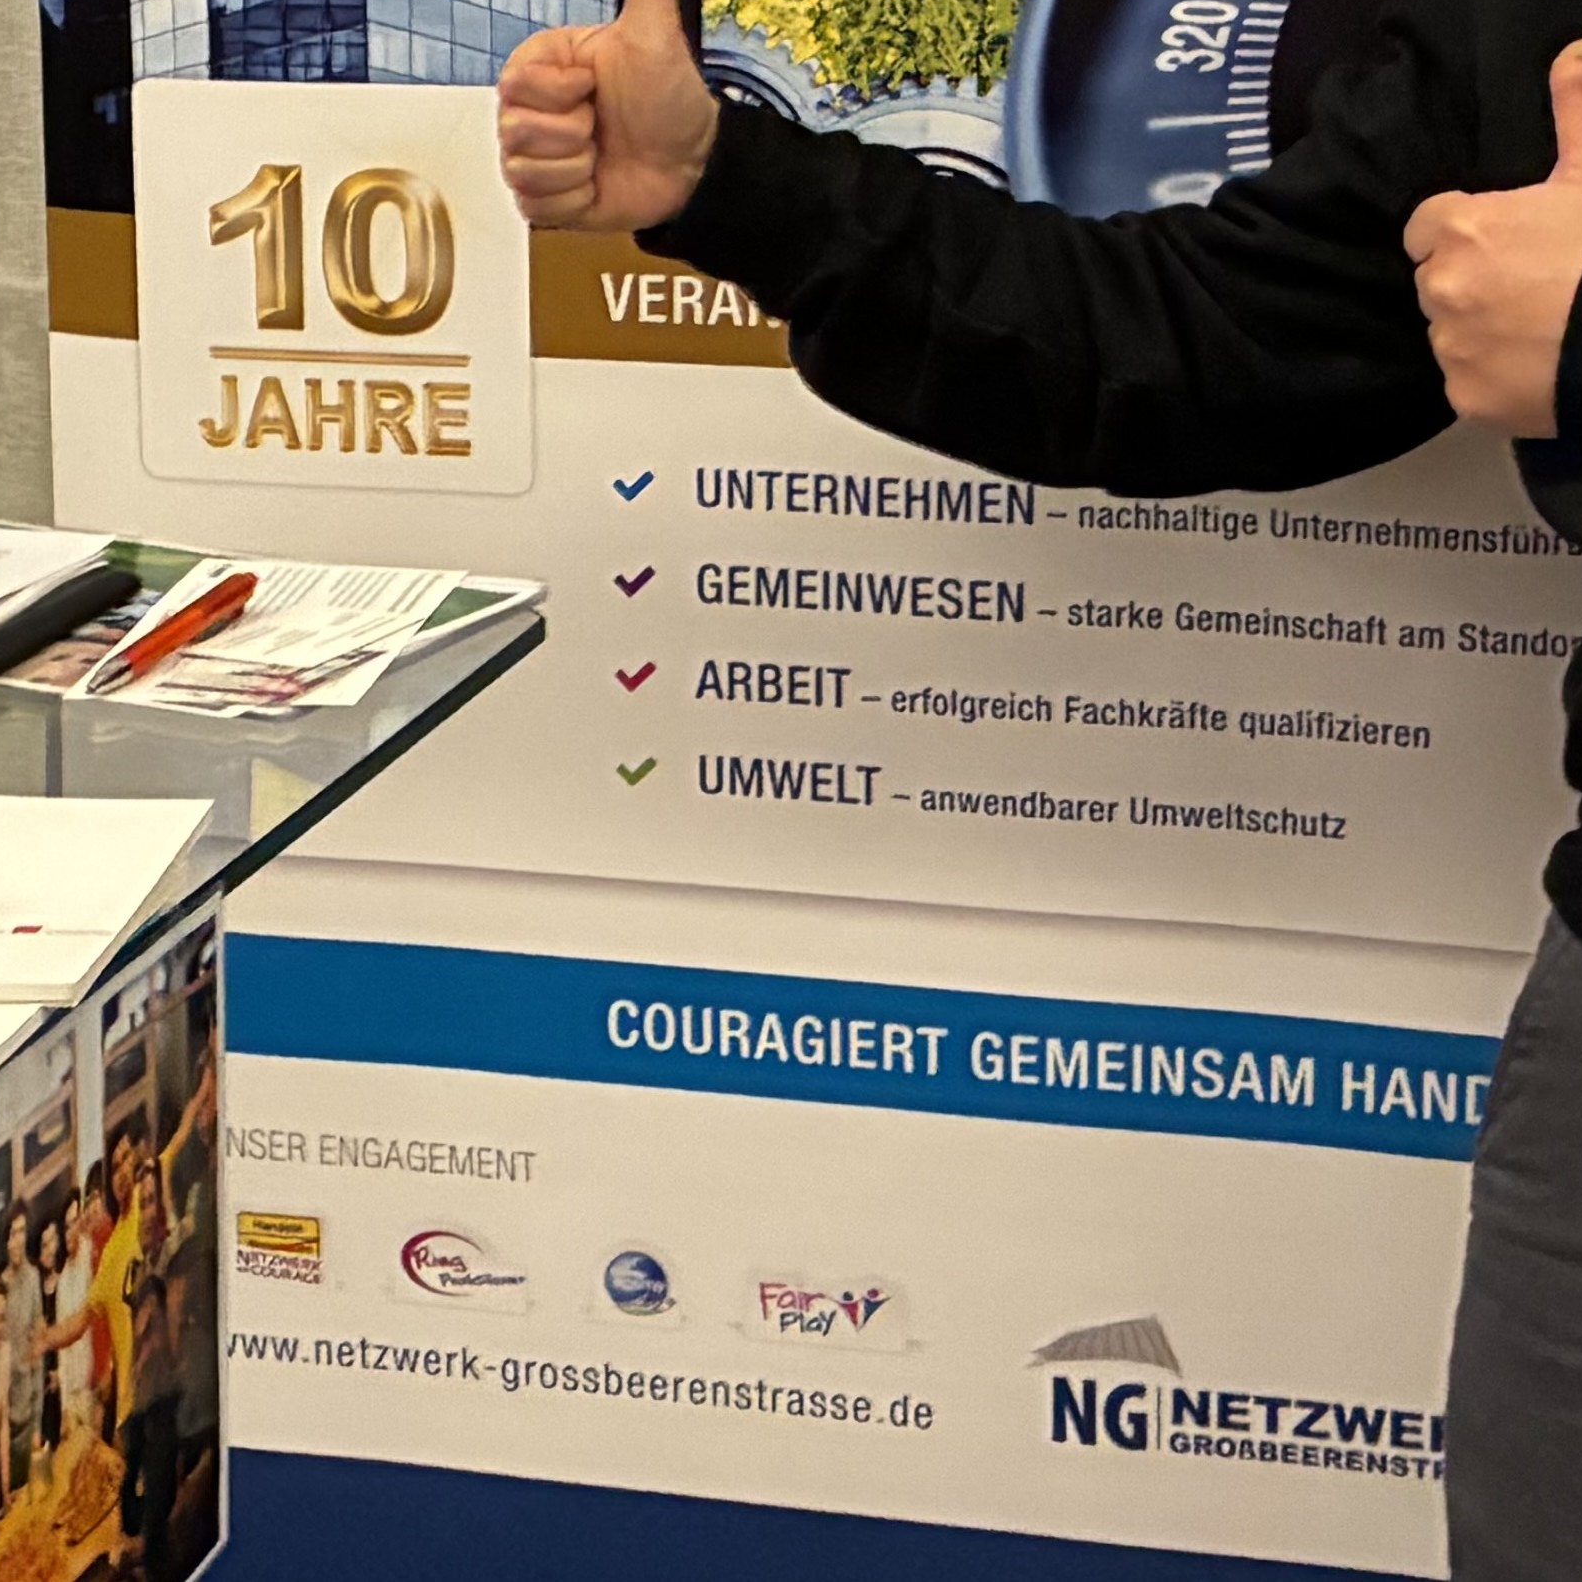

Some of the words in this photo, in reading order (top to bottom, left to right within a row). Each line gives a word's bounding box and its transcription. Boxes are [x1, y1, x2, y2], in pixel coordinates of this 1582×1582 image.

[208, 163, 457, 337] 10
[198, 374, 474, 457] JAHRE
[695, 468, 1036, 527] UNTERNEHMEN
[1078, 502, 1259, 541] nachhaltige
[1269, 508, 1582, 557] Unternehmensführ
[695, 563, 1026, 623] GEMEINWESEN
[1066, 598, 1164, 631] starke
[1174, 602, 1387, 647] Gemeinschaft
[1398, 625, 1446, 652] am
[695, 660, 852, 709] ARBEIT
[890, 685, 1053, 724] erfolgreich
[1065, 695, 1229, 732] Fachkräfte
[1238, 708, 1431, 750] qualifizieren
[697, 754, 883, 807] UMWELT
[919, 788, 1119, 825] anwendbarer
[1129, 796, 1348, 840] Umweltschutz
[606, 998, 949, 1077] COURAGIERT
[971, 1029, 1317, 1108] GEMEINSAM
[1341, 1061, 1493, 1126] HAND
[225, 1124, 307, 1165] NSER
[319, 1134, 537, 1183] ENGAGEMENT
[779, 1310, 838, 1337] Play
[1051, 1375, 1148, 1451] NG
